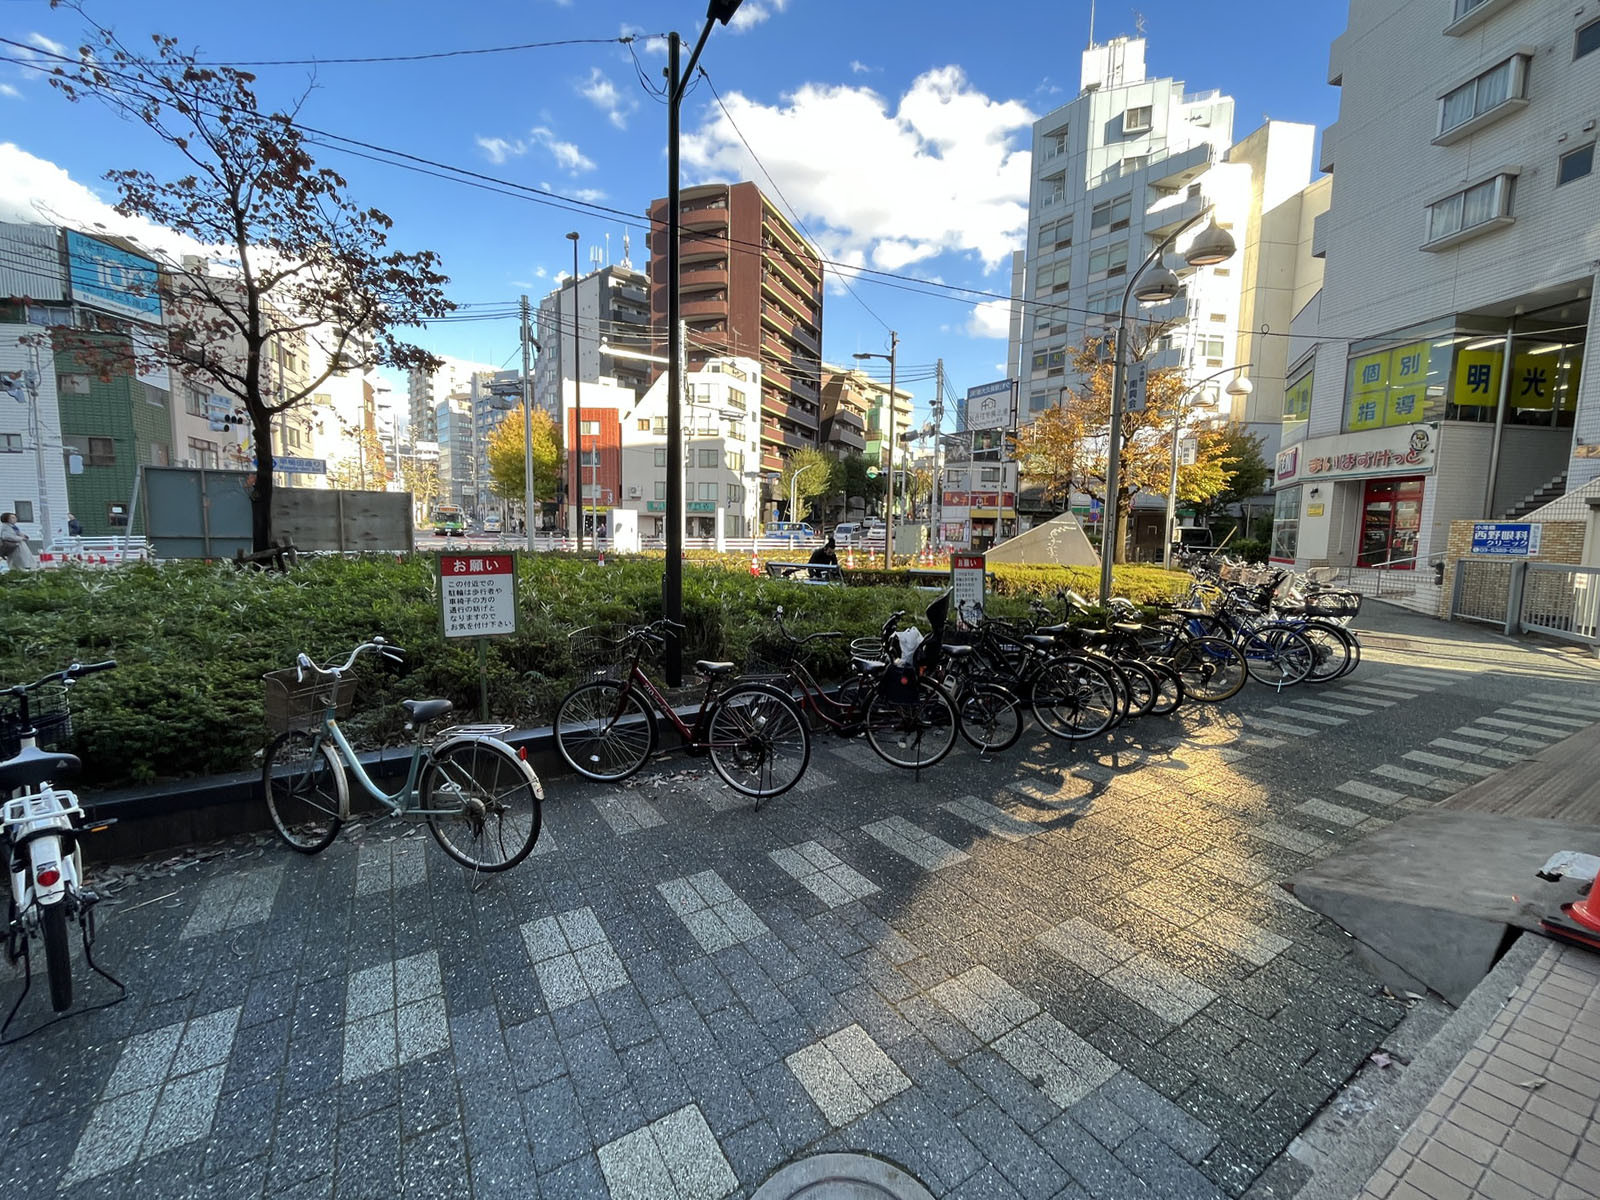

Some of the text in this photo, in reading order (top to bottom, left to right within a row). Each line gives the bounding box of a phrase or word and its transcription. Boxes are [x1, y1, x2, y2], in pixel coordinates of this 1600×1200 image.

[1363, 353, 1420, 384] 個別
[1467, 364, 1547, 397] 明光
[1358, 394, 1416, 422] 指導
[1308, 447, 1424, 474] まいばすけっと
[1474, 530, 1528, 540] 西野眼科
[453, 559, 499, 572] お願い
[448, 580, 495, 588] この付近での
[448, 588, 502, 597] 駐輪は歩行者や
[449, 597, 496, 605] 車椅子の方の
[449, 605, 495, 614] 通行の妨げと
[450, 613, 496, 622] なりますので
